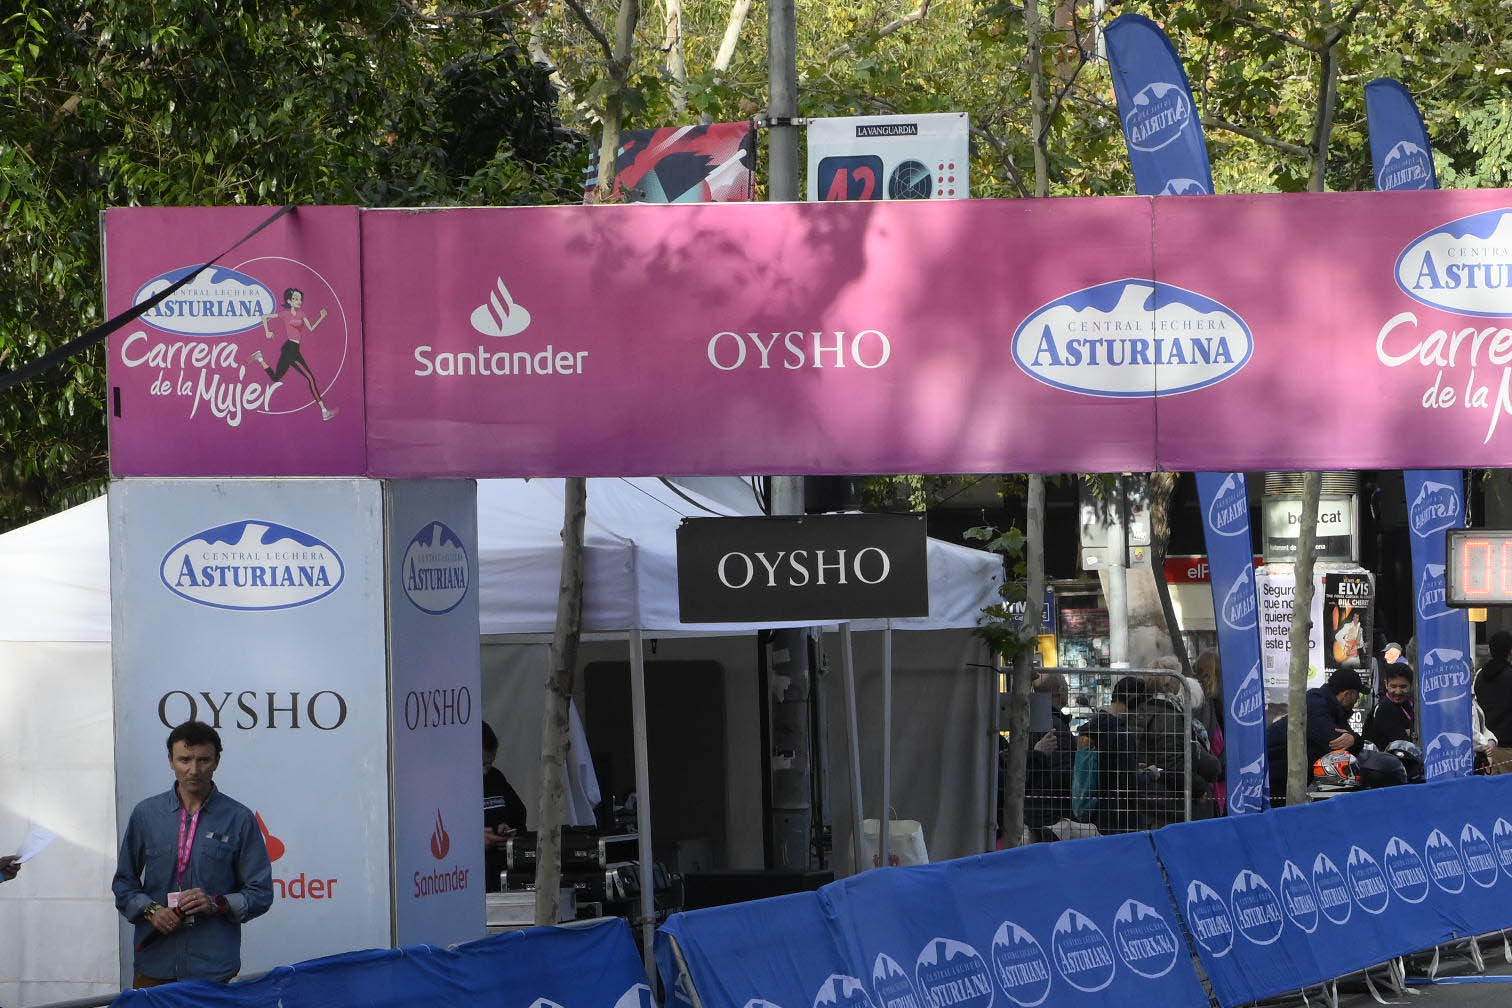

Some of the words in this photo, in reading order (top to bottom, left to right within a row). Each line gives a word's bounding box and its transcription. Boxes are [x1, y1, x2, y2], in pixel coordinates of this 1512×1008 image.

[144, 292, 265, 317] ASTURIANA
[215, 288, 261, 297] LECHERA
[1068, 320, 1143, 332] CENTRAL
[1151, 319, 1226, 331] LECHERA
[121, 331, 239, 368] Carrera
[414, 345, 589, 376] Santander
[707, 330, 892, 371] OYSHO
[1030, 324, 1234, 367] ASTURIANA
[151, 370, 172, 396] de
[177, 370, 193, 396] la
[189, 365, 284, 427] Mujer
[1422, 370, 1456, 409] de
[1464, 368, 1489, 409] la
[175, 553, 331, 587] ASTURIANA
[202, 551, 260, 561] CENTRAL
[266, 550, 324, 561] LECHERA
[718, 547, 890, 589] OYSHO
[407, 558, 466, 591] ASTURIANA
[1338, 582, 1369, 596] ELVIS
[1264, 600, 1281, 610] que
[1264, 612, 1296, 625] quiere
[1265, 638, 1284, 649] este
[157, 690, 348, 731] OYSHO
[404, 685, 472, 731] OYSHO
[414, 863, 470, 899] Santander
